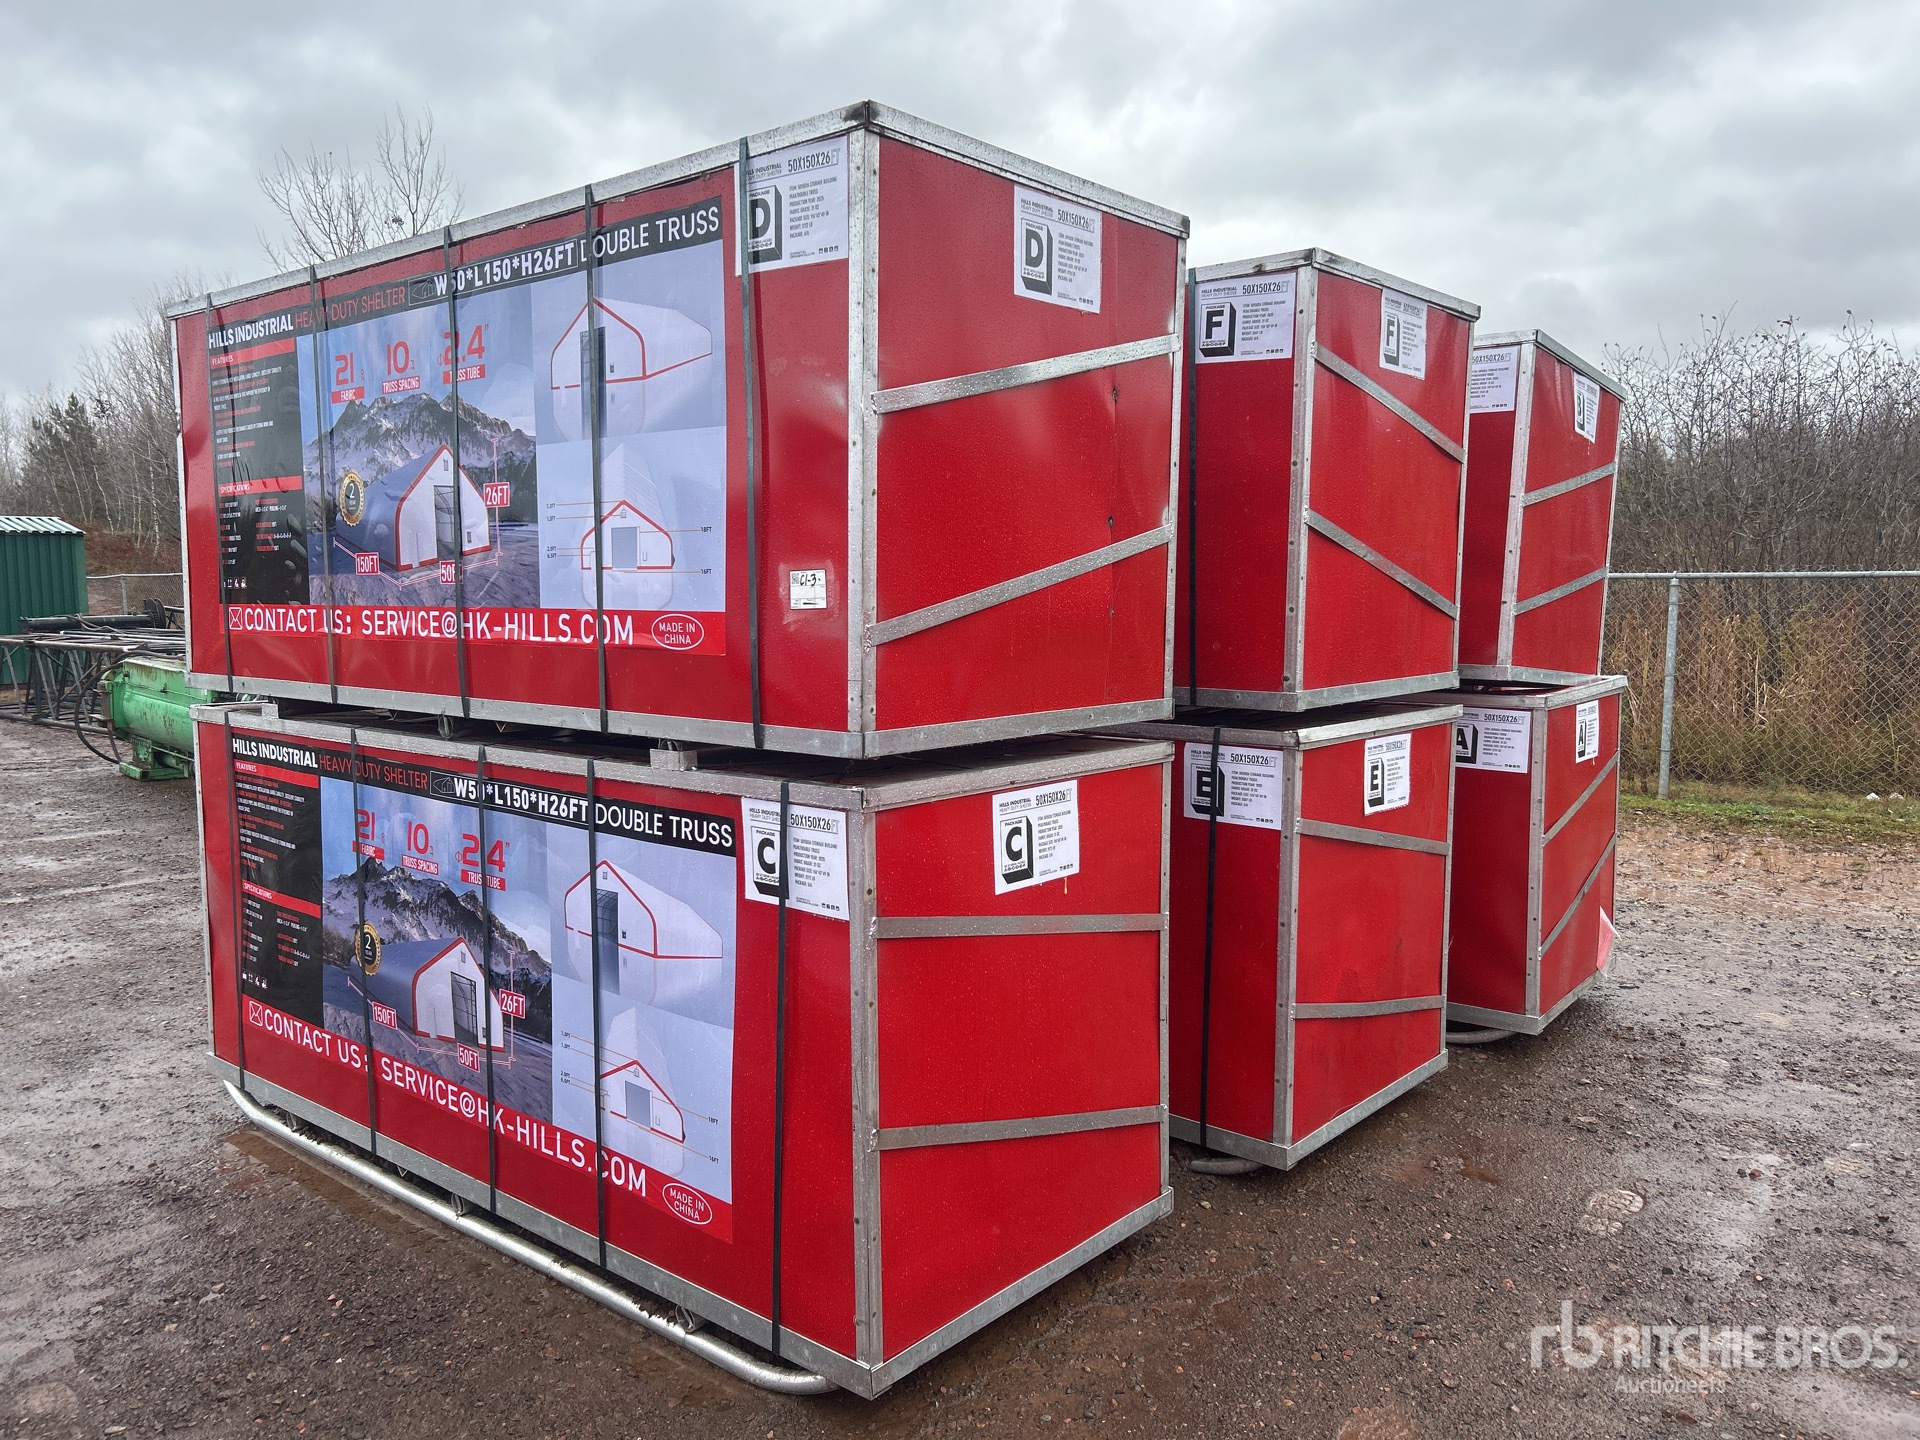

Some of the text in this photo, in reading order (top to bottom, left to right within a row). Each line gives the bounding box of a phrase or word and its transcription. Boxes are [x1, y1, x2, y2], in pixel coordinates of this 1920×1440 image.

[749, 197, 771, 240] D
[1025, 228, 1044, 268] D
[208, 329, 235, 350] HILLS
[235, 313, 294, 342] INDUSTRIAL
[331, 299, 359, 321] DUTY
[361, 286, 406, 313] SHELTER
[655, 206, 719, 243] TRUSS
[1205, 309, 1225, 340] F
[1386, 318, 1396, 347] F
[335, 351, 354, 386] 21
[386, 340, 410, 376] 10
[382, 376, 419, 394] TRUSS SPACING
[467, 366, 481, 380] TUBE
[350, 483, 355, 498] 2
[486, 486, 509, 506] 26FT
[357, 554, 378, 574] 150FT
[244, 607, 633, 646] CONTACT US: SERVICE@HK-HILLS.COM
[659, 622, 696, 633] MADE IN
[664, 633, 692, 645] CHINA
[1456, 727, 1469, 750] A
[1578, 724, 1584, 746] A
[235, 761, 257, 773] FEATURES
[1370, 764, 1379, 791] E
[232, 738, 257, 757] HILLS
[259, 742, 318, 768] INDUSTRIAL
[319, 754, 352, 775] HEAVY
[355, 760, 381, 780] DUTY
[384, 764, 427, 790] SHELTER
[595, 803, 662, 836] DOUBLE
[669, 815, 733, 848] TRUSS
[357, 808, 375, 842] 21
[407, 820, 429, 855] 10
[757, 837, 776, 875] C
[1005, 826, 1023, 862] C
[402, 855, 438, 875] TRUSS SPACING
[468, 871, 501, 889] TRUS TUBE
[365, 934, 371, 949] 2
[501, 992, 524, 1017] 26FT
[373, 1007, 396, 1028] 150FT
[459, 1048, 479, 1070] 50FT
[264, 1009, 331, 1056] CONTACT
[381, 1056, 646, 1197] SERVICE@HK-HILLS.COM
[669, 1187, 705, 1212] MADE IN
[674, 1202, 701, 1221] CHINA
